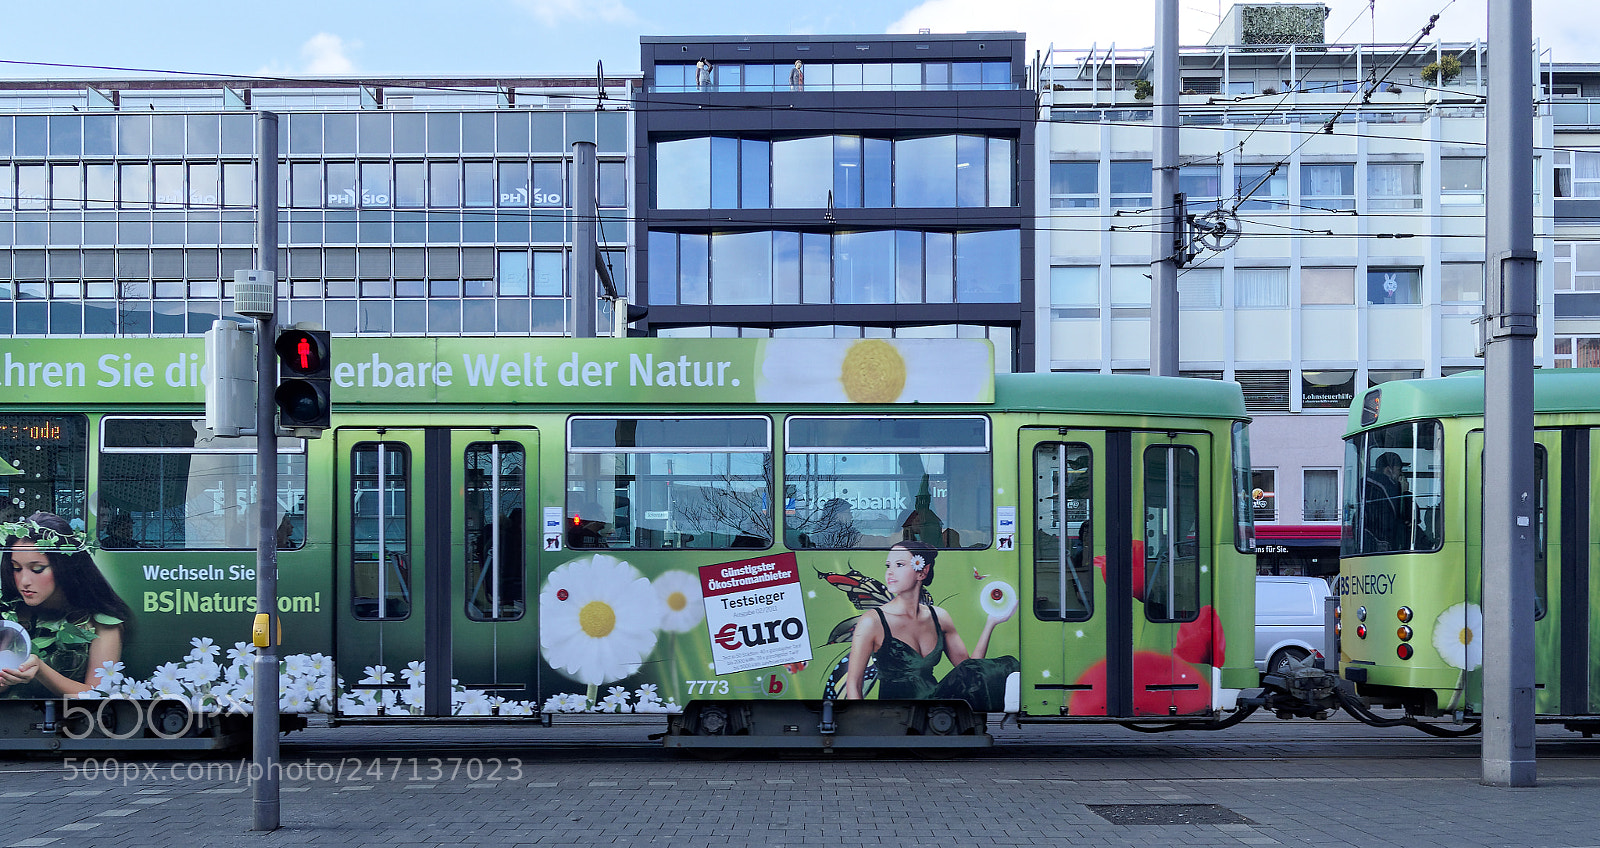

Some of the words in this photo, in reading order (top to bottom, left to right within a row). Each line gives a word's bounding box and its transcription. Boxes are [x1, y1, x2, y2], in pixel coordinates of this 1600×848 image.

[328, 185, 389, 204] PHYSIO
[500, 185, 561, 204] PHYSIO
[0, 353, 86, 387] hren
[97, 353, 155, 387] Sie
[334, 352, 453, 388] erbare
[463, 352, 548, 387] Welt
[557, 352, 619, 387] der
[629, 353, 740, 387] Natur.
[1265, 545, 1276, 553] für
[1276, 545, 1289, 553] Sie.
[143, 564, 225, 581] Wechseln
[228, 564, 256, 581] Sie
[721, 562, 776, 578] Günstigster
[708, 570, 792, 591] Ökostromanbieter
[1340, 576, 1350, 595] BS
[1351, 574, 1396, 595] ENERGY
[721, 591, 785, 610] Testsieger
[714, 617, 804, 651] €uro
[685, 680, 729, 695] 7773
